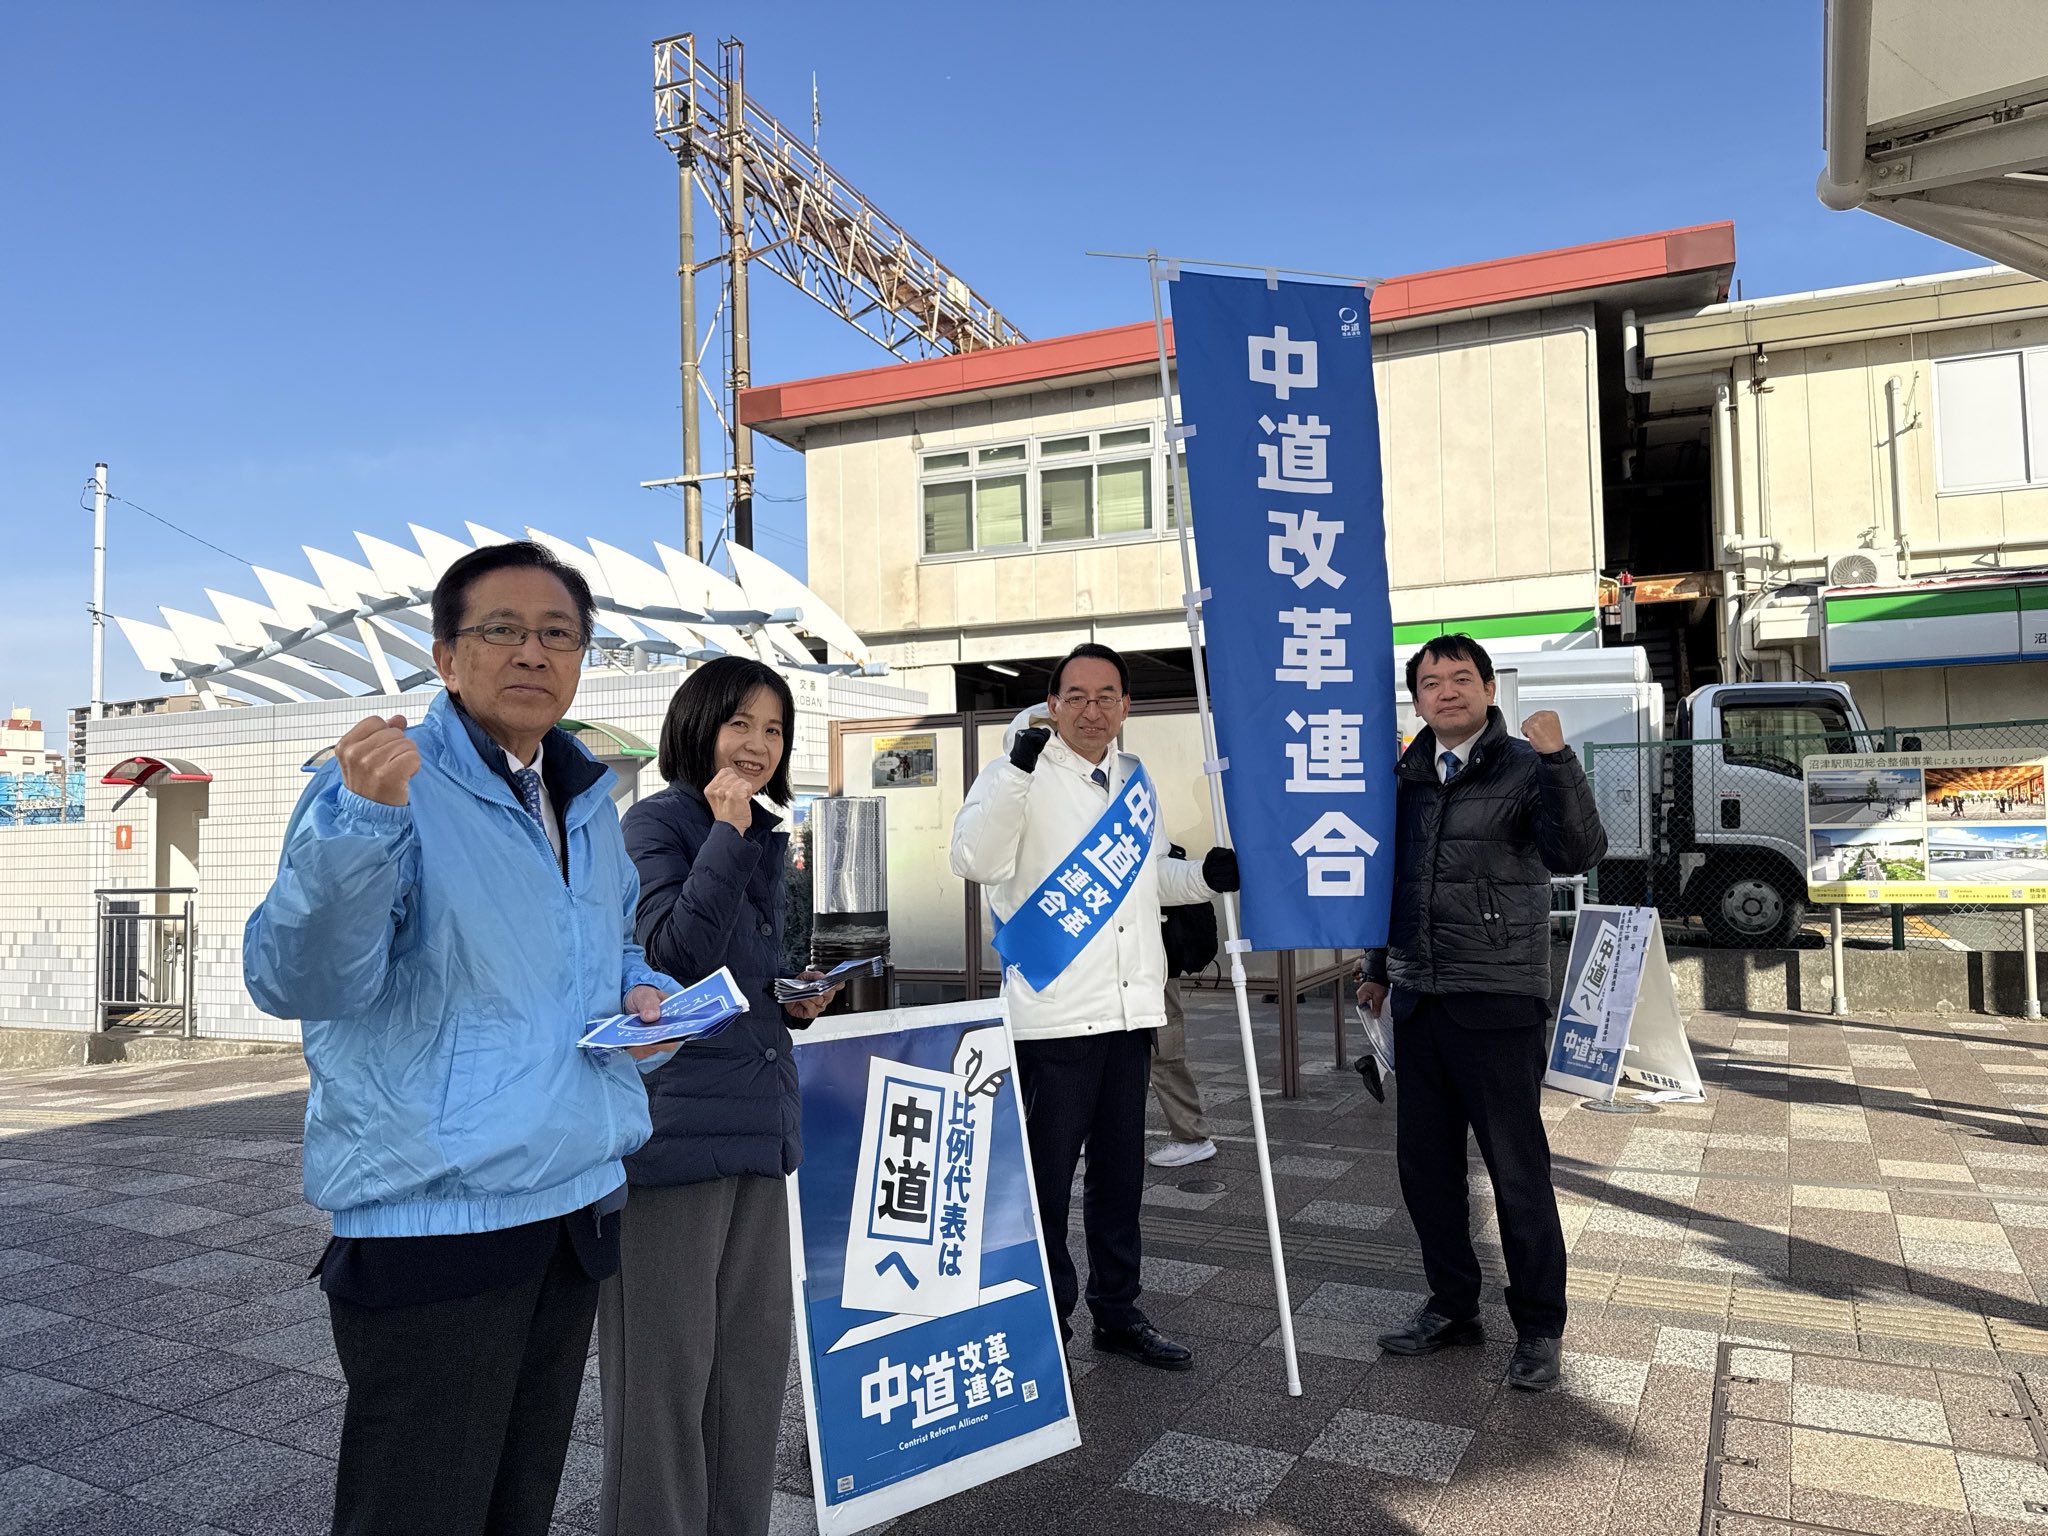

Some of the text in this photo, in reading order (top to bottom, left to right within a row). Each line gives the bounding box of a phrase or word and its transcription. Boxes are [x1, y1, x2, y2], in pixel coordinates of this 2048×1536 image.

[1341, 323, 1360, 332] 中道
[1248, 325, 1379, 897] 中道改革連合
[800, 680, 816, 691] 交番
[1809, 752, 2042, 770] 沼津駅周辺総合整備事業によるまちづくりのイメージ
[1082, 781, 1155, 890] 中道
[1037, 863, 1086, 917] 連合
[1058, 883, 1113, 938] 改革
[1587, 938, 1615, 993] 中道
[1563, 1028, 1593, 1062] 中道
[938, 1090, 977, 1277] 比例代表は
[860, 1332, 1010, 1430] 中道 改革
[963, 1368, 1015, 1411] 連合
[898, 1413, 989, 1450] Centrist Reform Alliance
